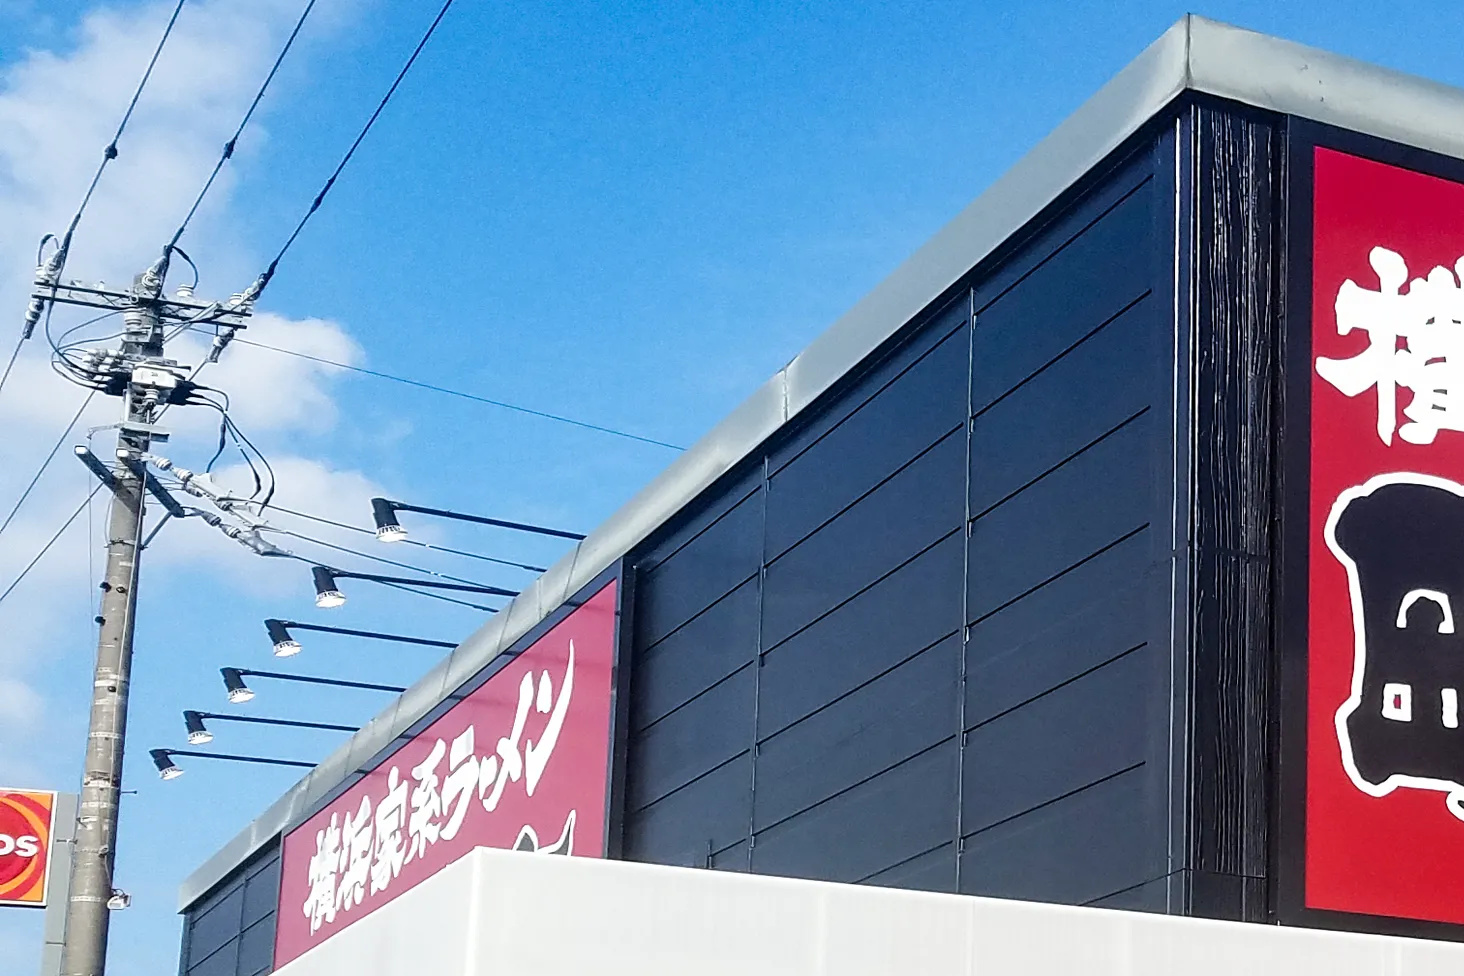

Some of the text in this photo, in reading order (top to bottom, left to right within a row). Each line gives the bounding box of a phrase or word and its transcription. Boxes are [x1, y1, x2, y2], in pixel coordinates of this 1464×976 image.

[303, 639, 575, 936] 横浜家系ラーメン
